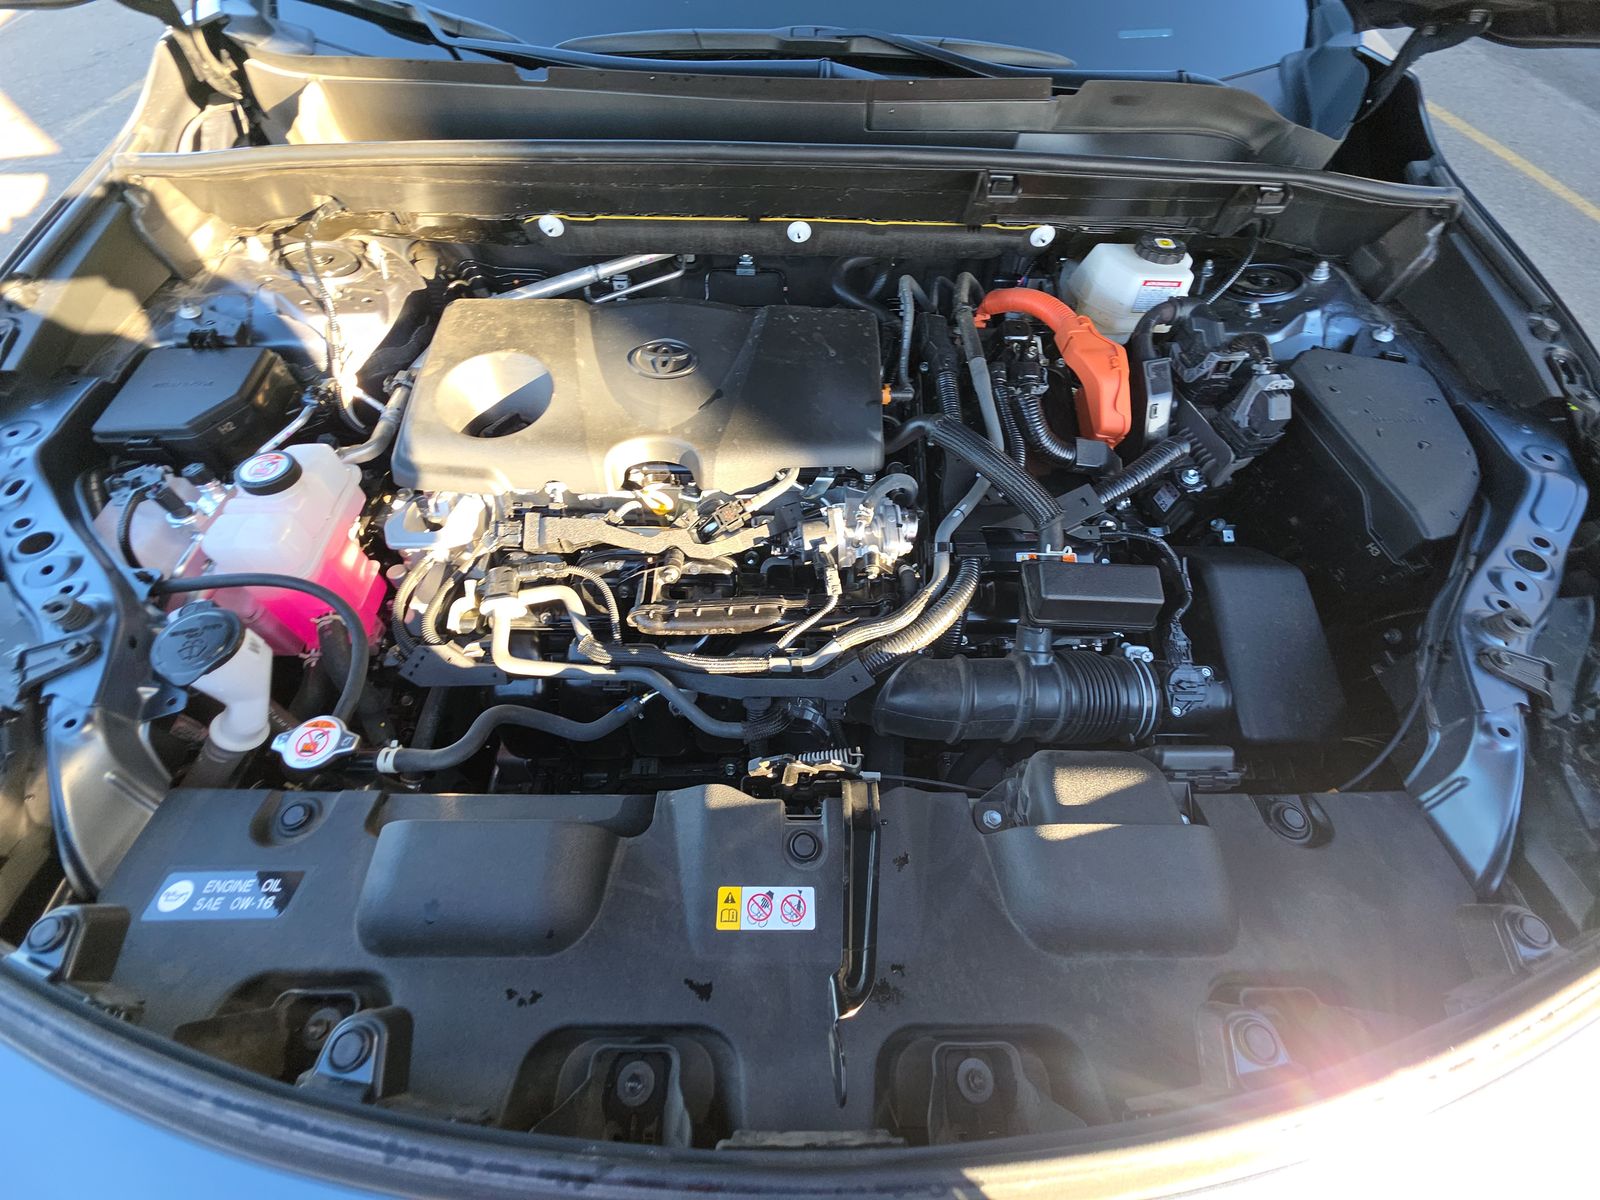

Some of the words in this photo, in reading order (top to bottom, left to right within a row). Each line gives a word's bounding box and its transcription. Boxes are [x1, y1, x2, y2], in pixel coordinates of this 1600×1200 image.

[202, 878, 256, 894] ENGINE
[260, 878, 282, 893] OIL
[192, 896, 225, 911] SAE
[229, 896, 275, 911] 0W-16
